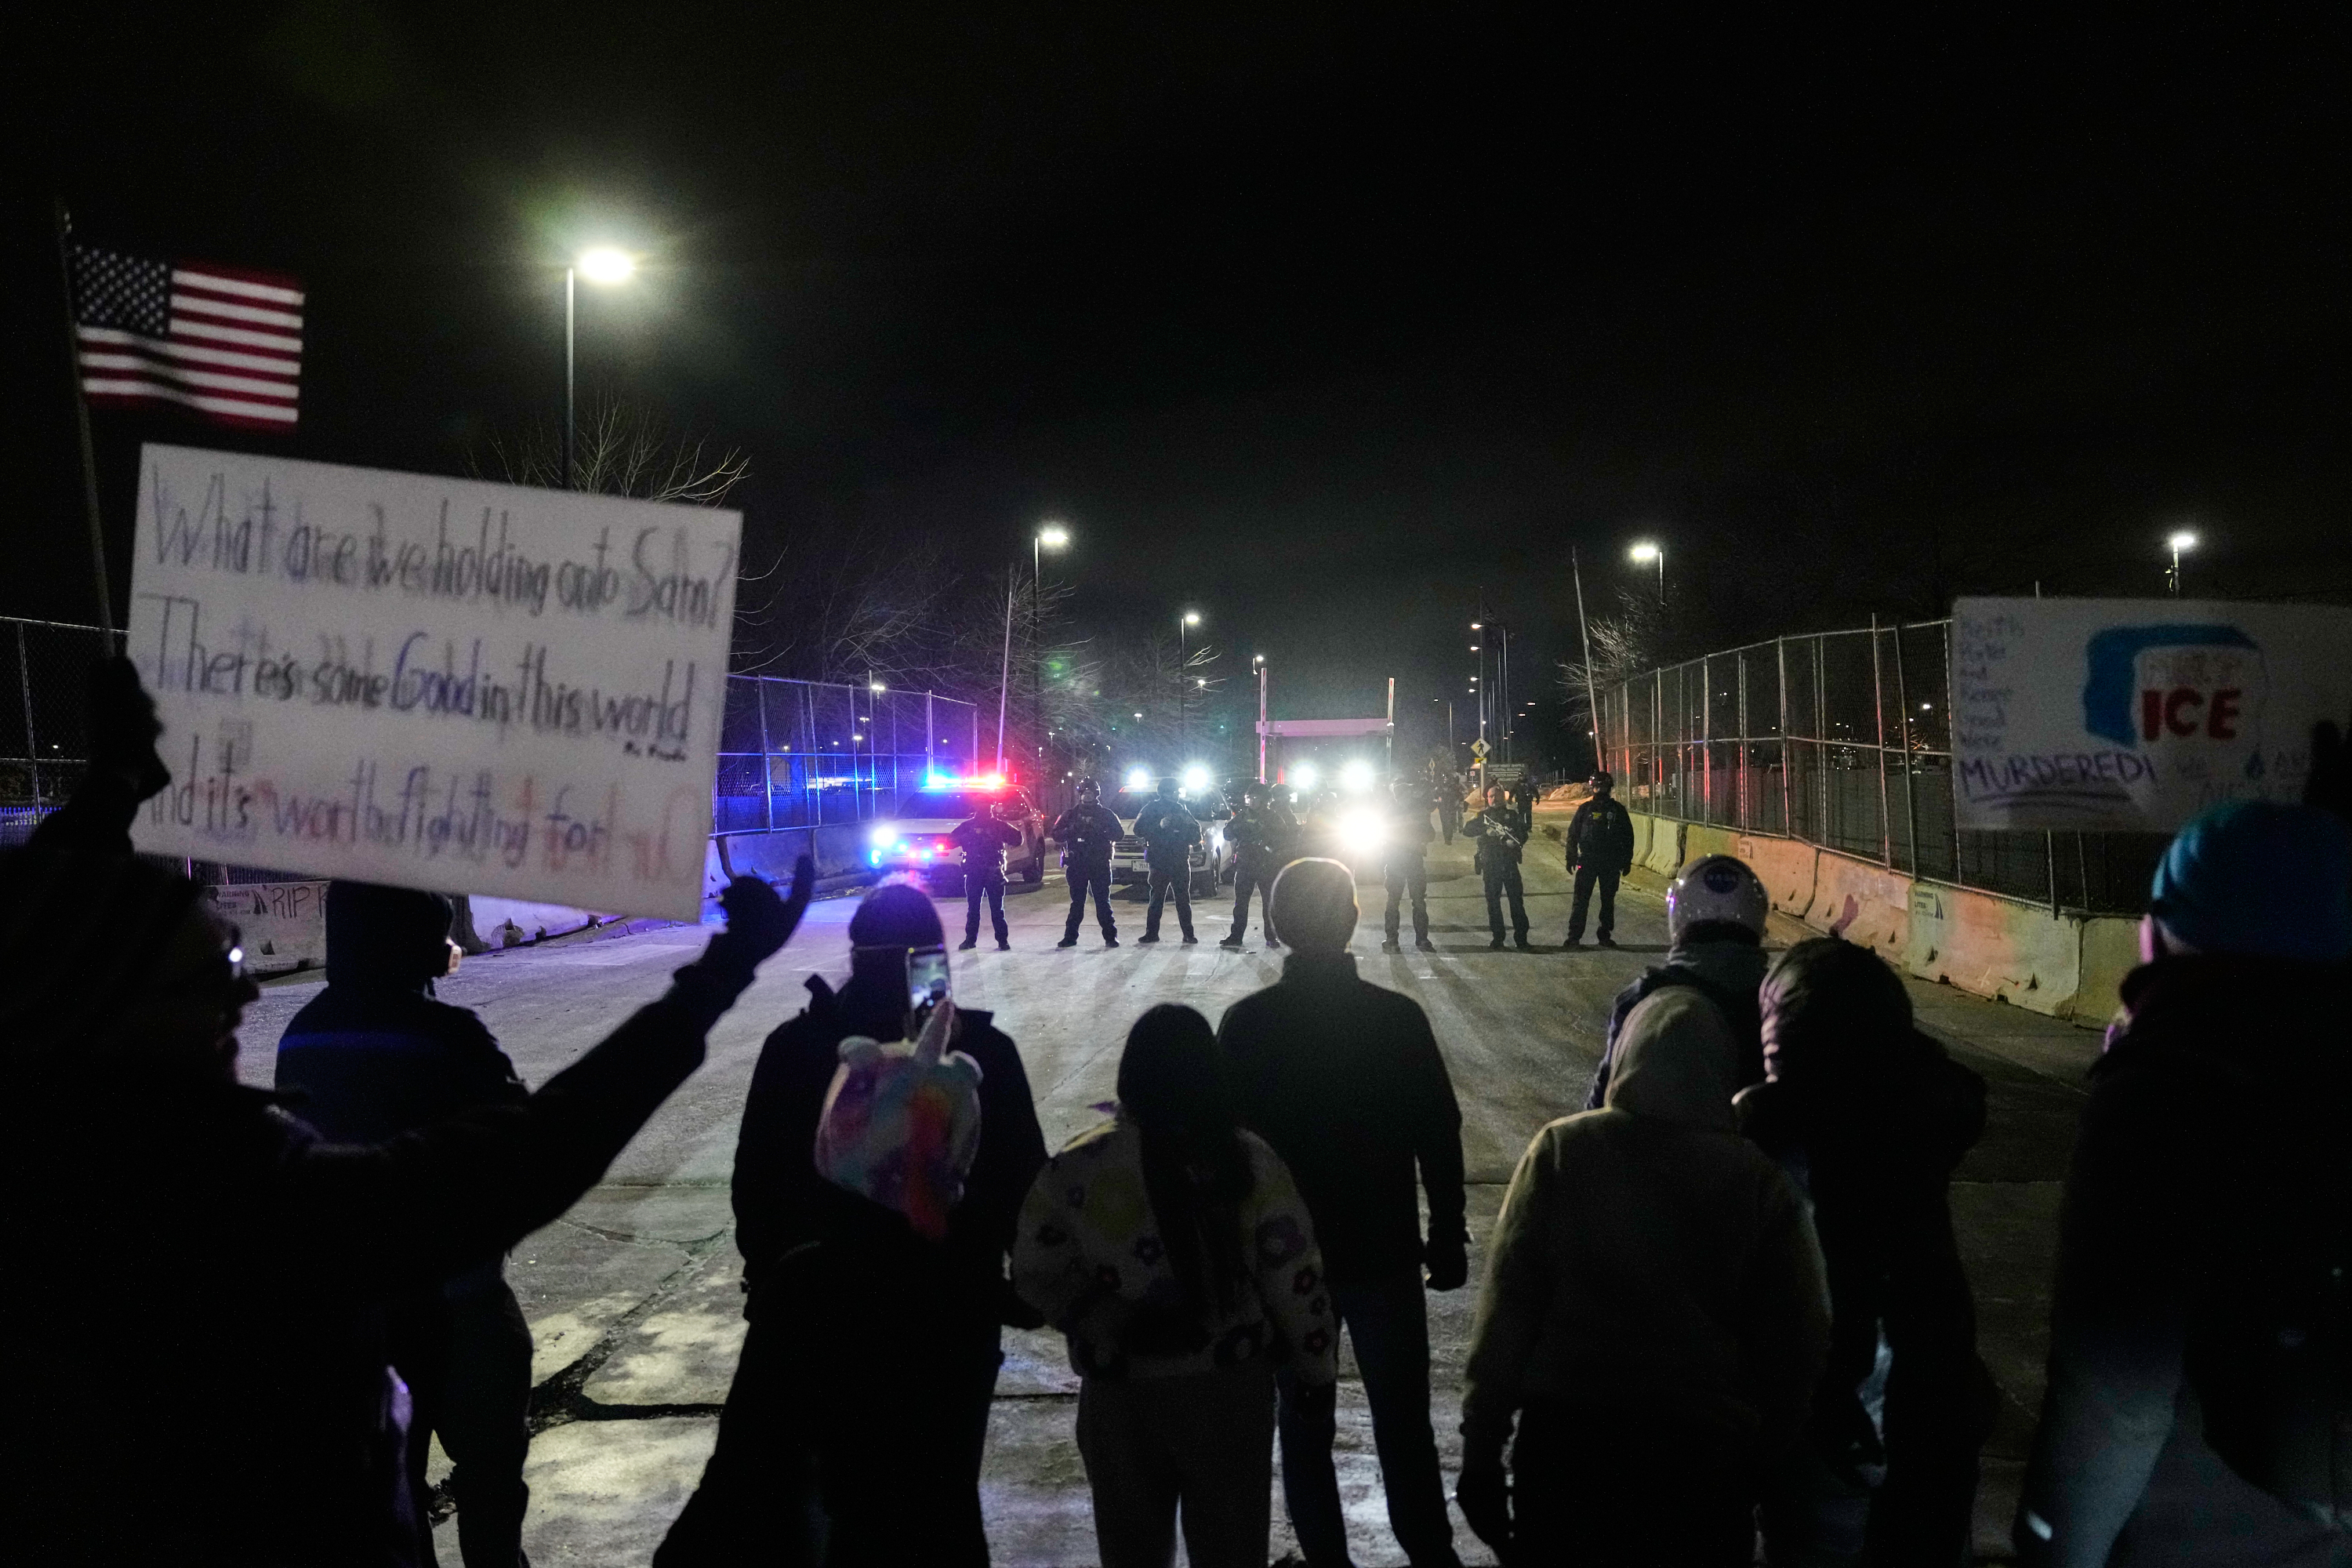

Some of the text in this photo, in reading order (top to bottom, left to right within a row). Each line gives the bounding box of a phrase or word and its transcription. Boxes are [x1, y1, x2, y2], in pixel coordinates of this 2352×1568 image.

[151, 464, 735, 629] What are we holding onto Sam?
[136, 591, 695, 741] There's some Good in this world
[2143, 688, 2241, 742] ICE
[151, 735, 199, 826] nd
[274, 759, 384, 842] worth
[398, 765, 531, 868] fighting
[272, 887, 310, 919] RIP
